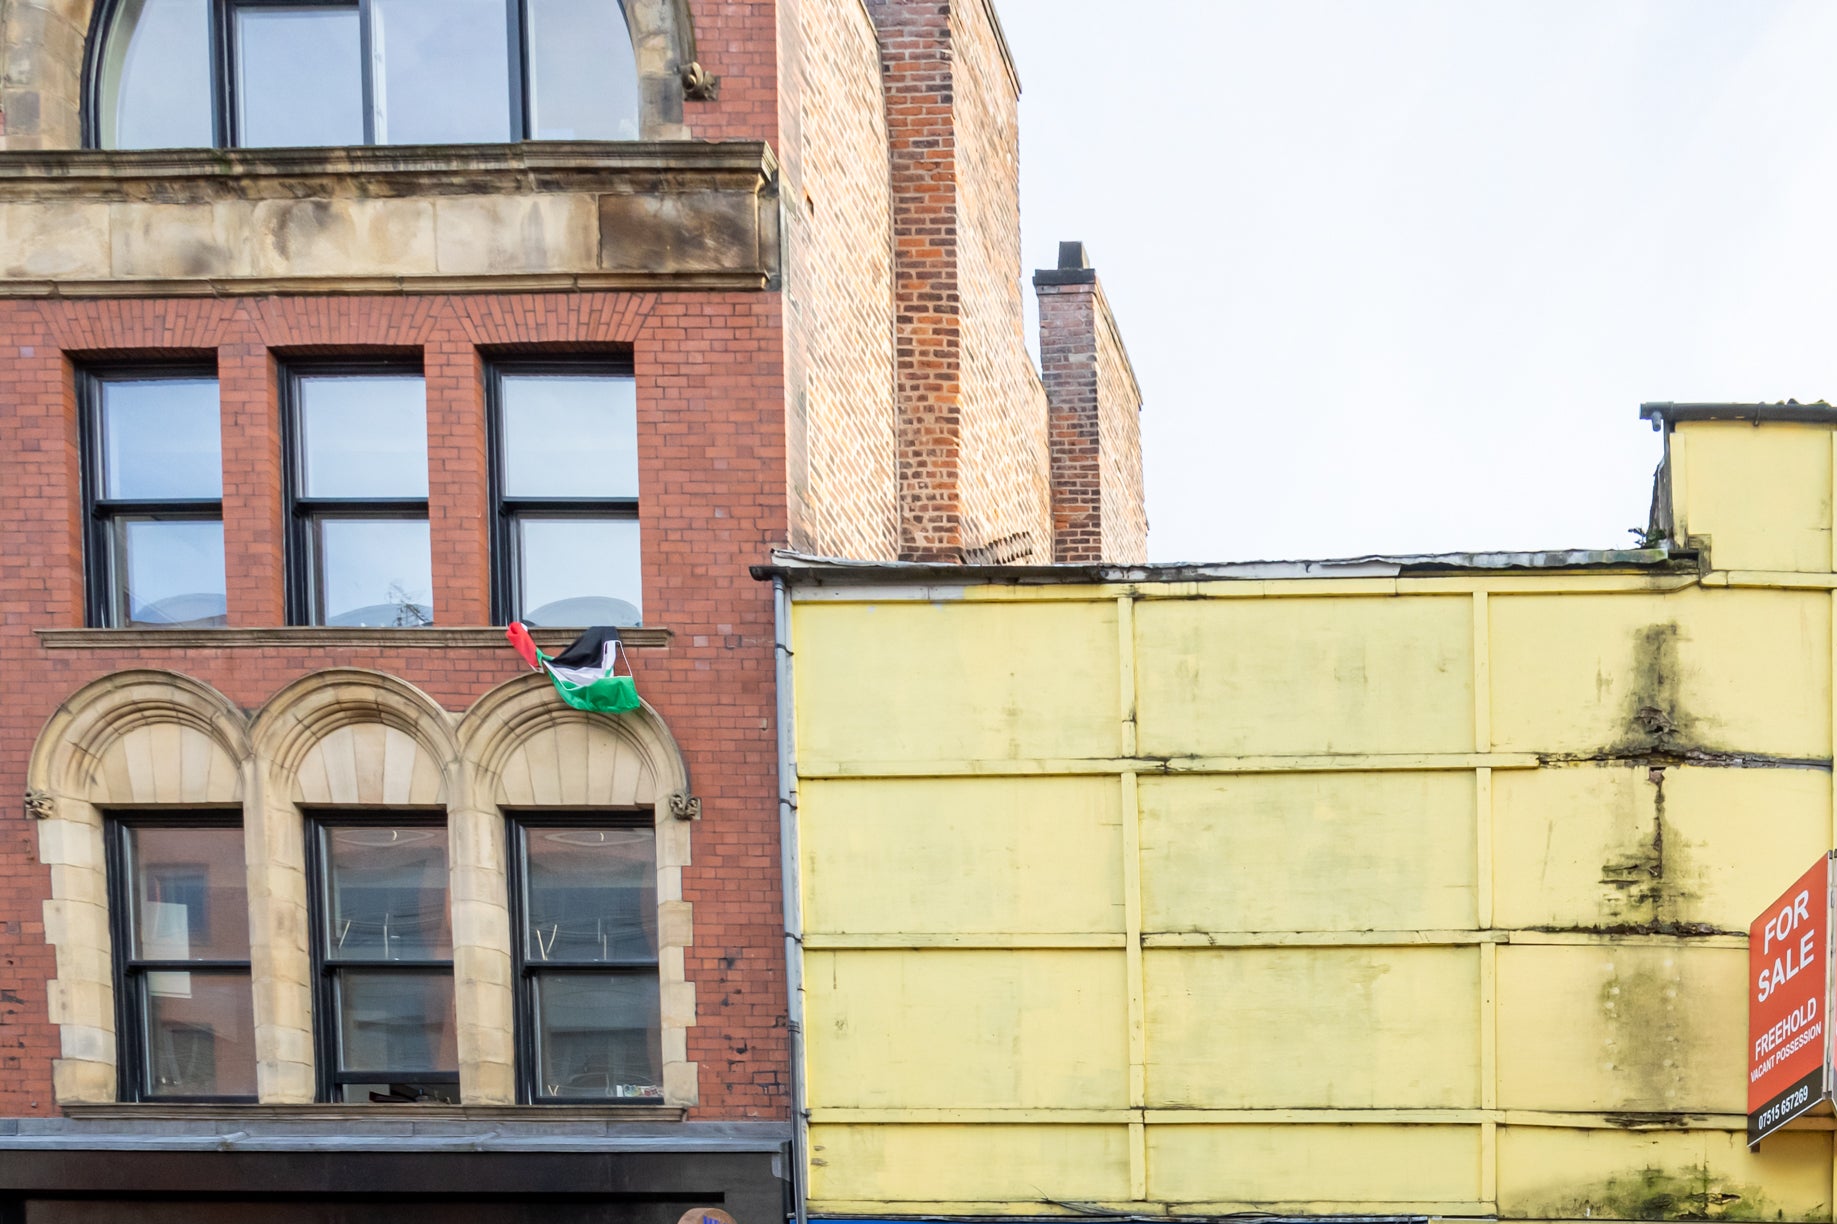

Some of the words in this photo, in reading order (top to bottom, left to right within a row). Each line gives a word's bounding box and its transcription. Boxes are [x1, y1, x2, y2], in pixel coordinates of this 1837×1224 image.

[1763, 890, 1809, 955] FOR
[1758, 929, 1815, 1003] SALE
[1750, 1055, 1775, 1083] VACANT
[1775, 1022, 1822, 1065] POSSESSION
[1755, 997, 1816, 1060] FREEHOLD
[1758, 1099, 1780, 1130] 07515
[1780, 1085, 1809, 1120] 657269
